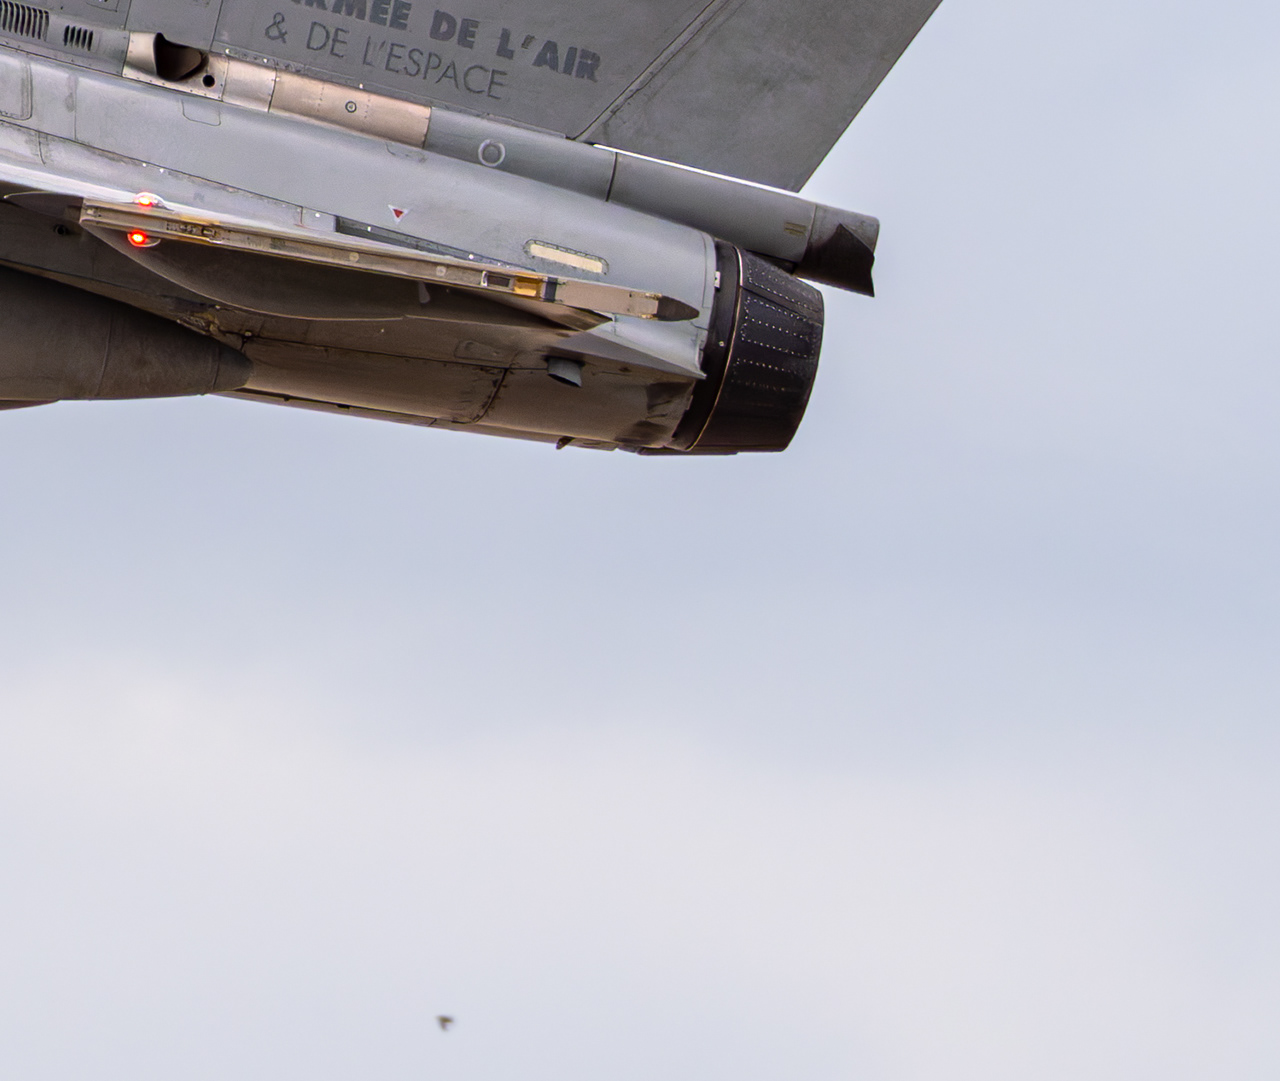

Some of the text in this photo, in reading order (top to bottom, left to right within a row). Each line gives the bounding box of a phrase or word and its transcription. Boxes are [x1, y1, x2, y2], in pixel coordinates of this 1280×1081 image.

[264, 11, 509, 101] & DE L'ESPACE
[429, 9, 480, 50] DE
[495, 27, 602, 83] L'AIR
